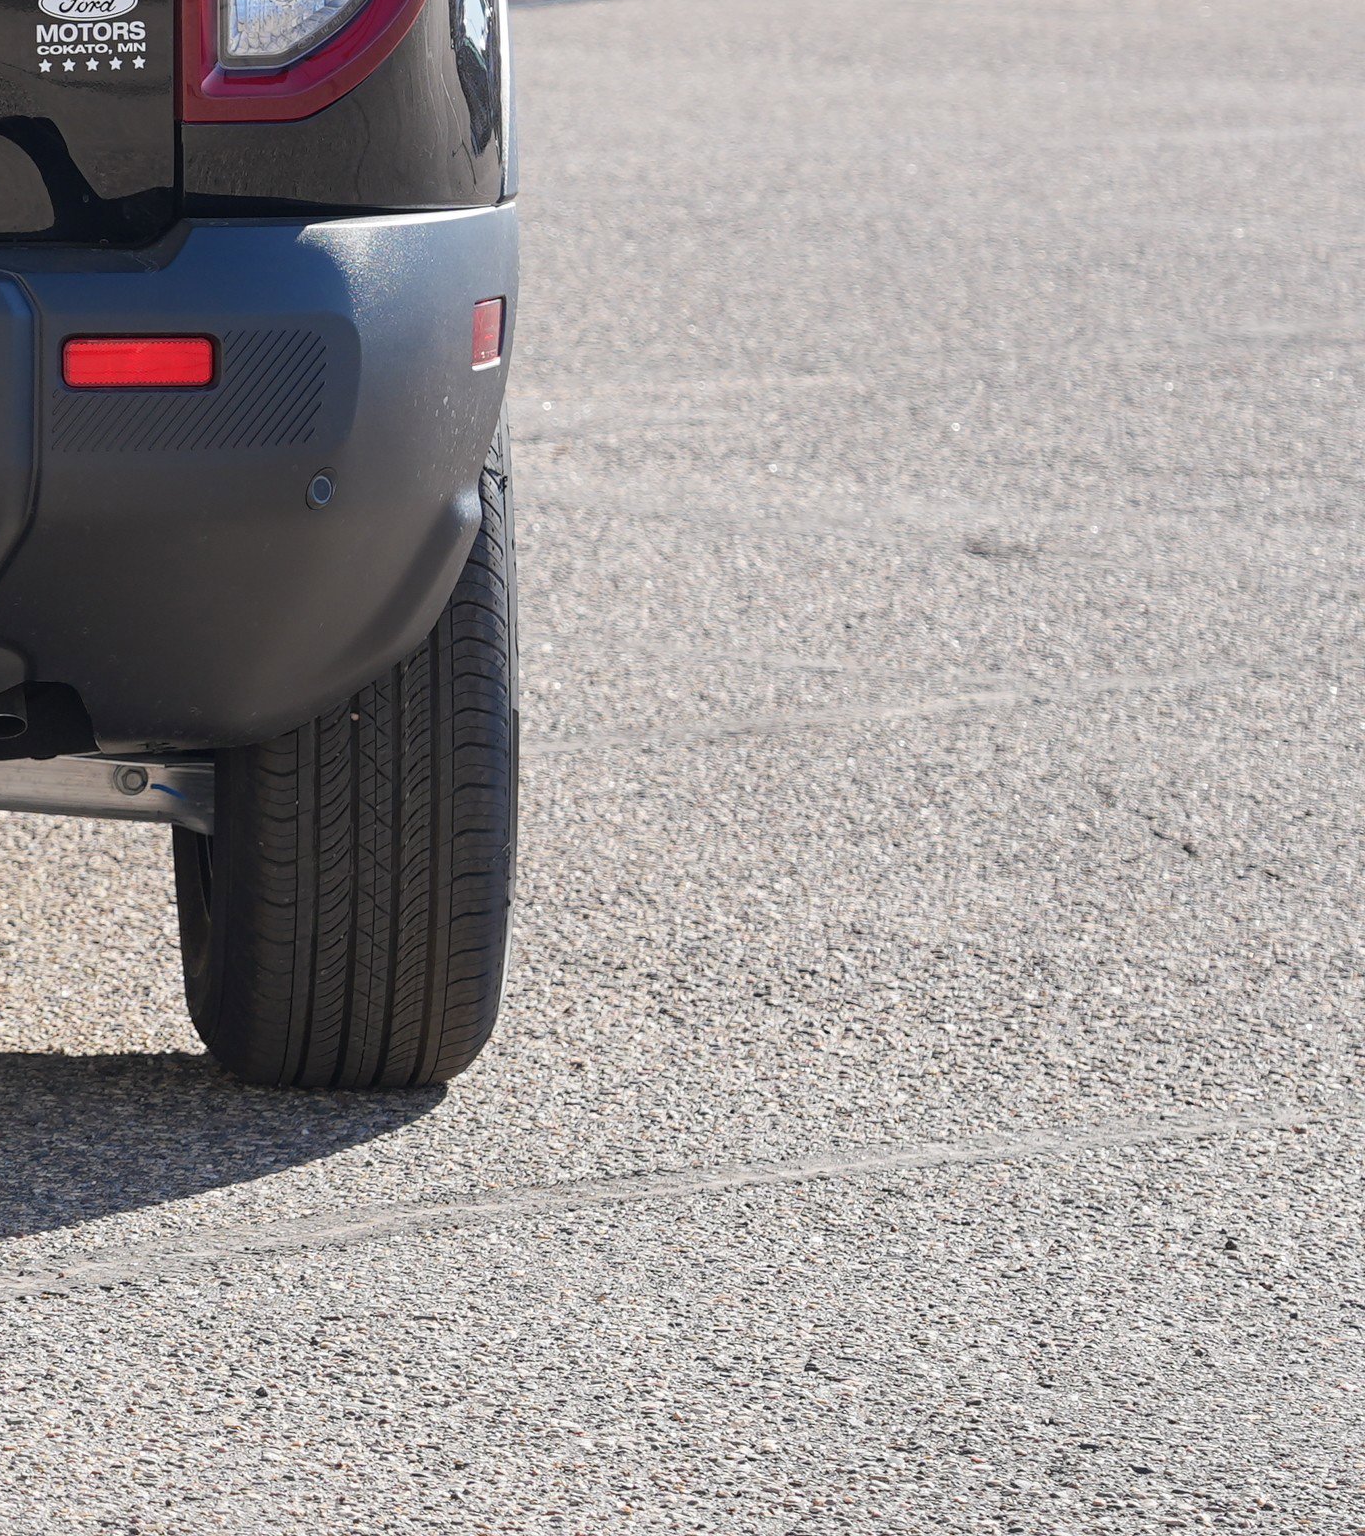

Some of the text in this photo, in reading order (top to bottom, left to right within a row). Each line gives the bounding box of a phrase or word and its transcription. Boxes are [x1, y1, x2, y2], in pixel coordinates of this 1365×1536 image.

[36, 21, 146, 43] MOTORS
[36, 42, 146, 56] COKATO, MN
